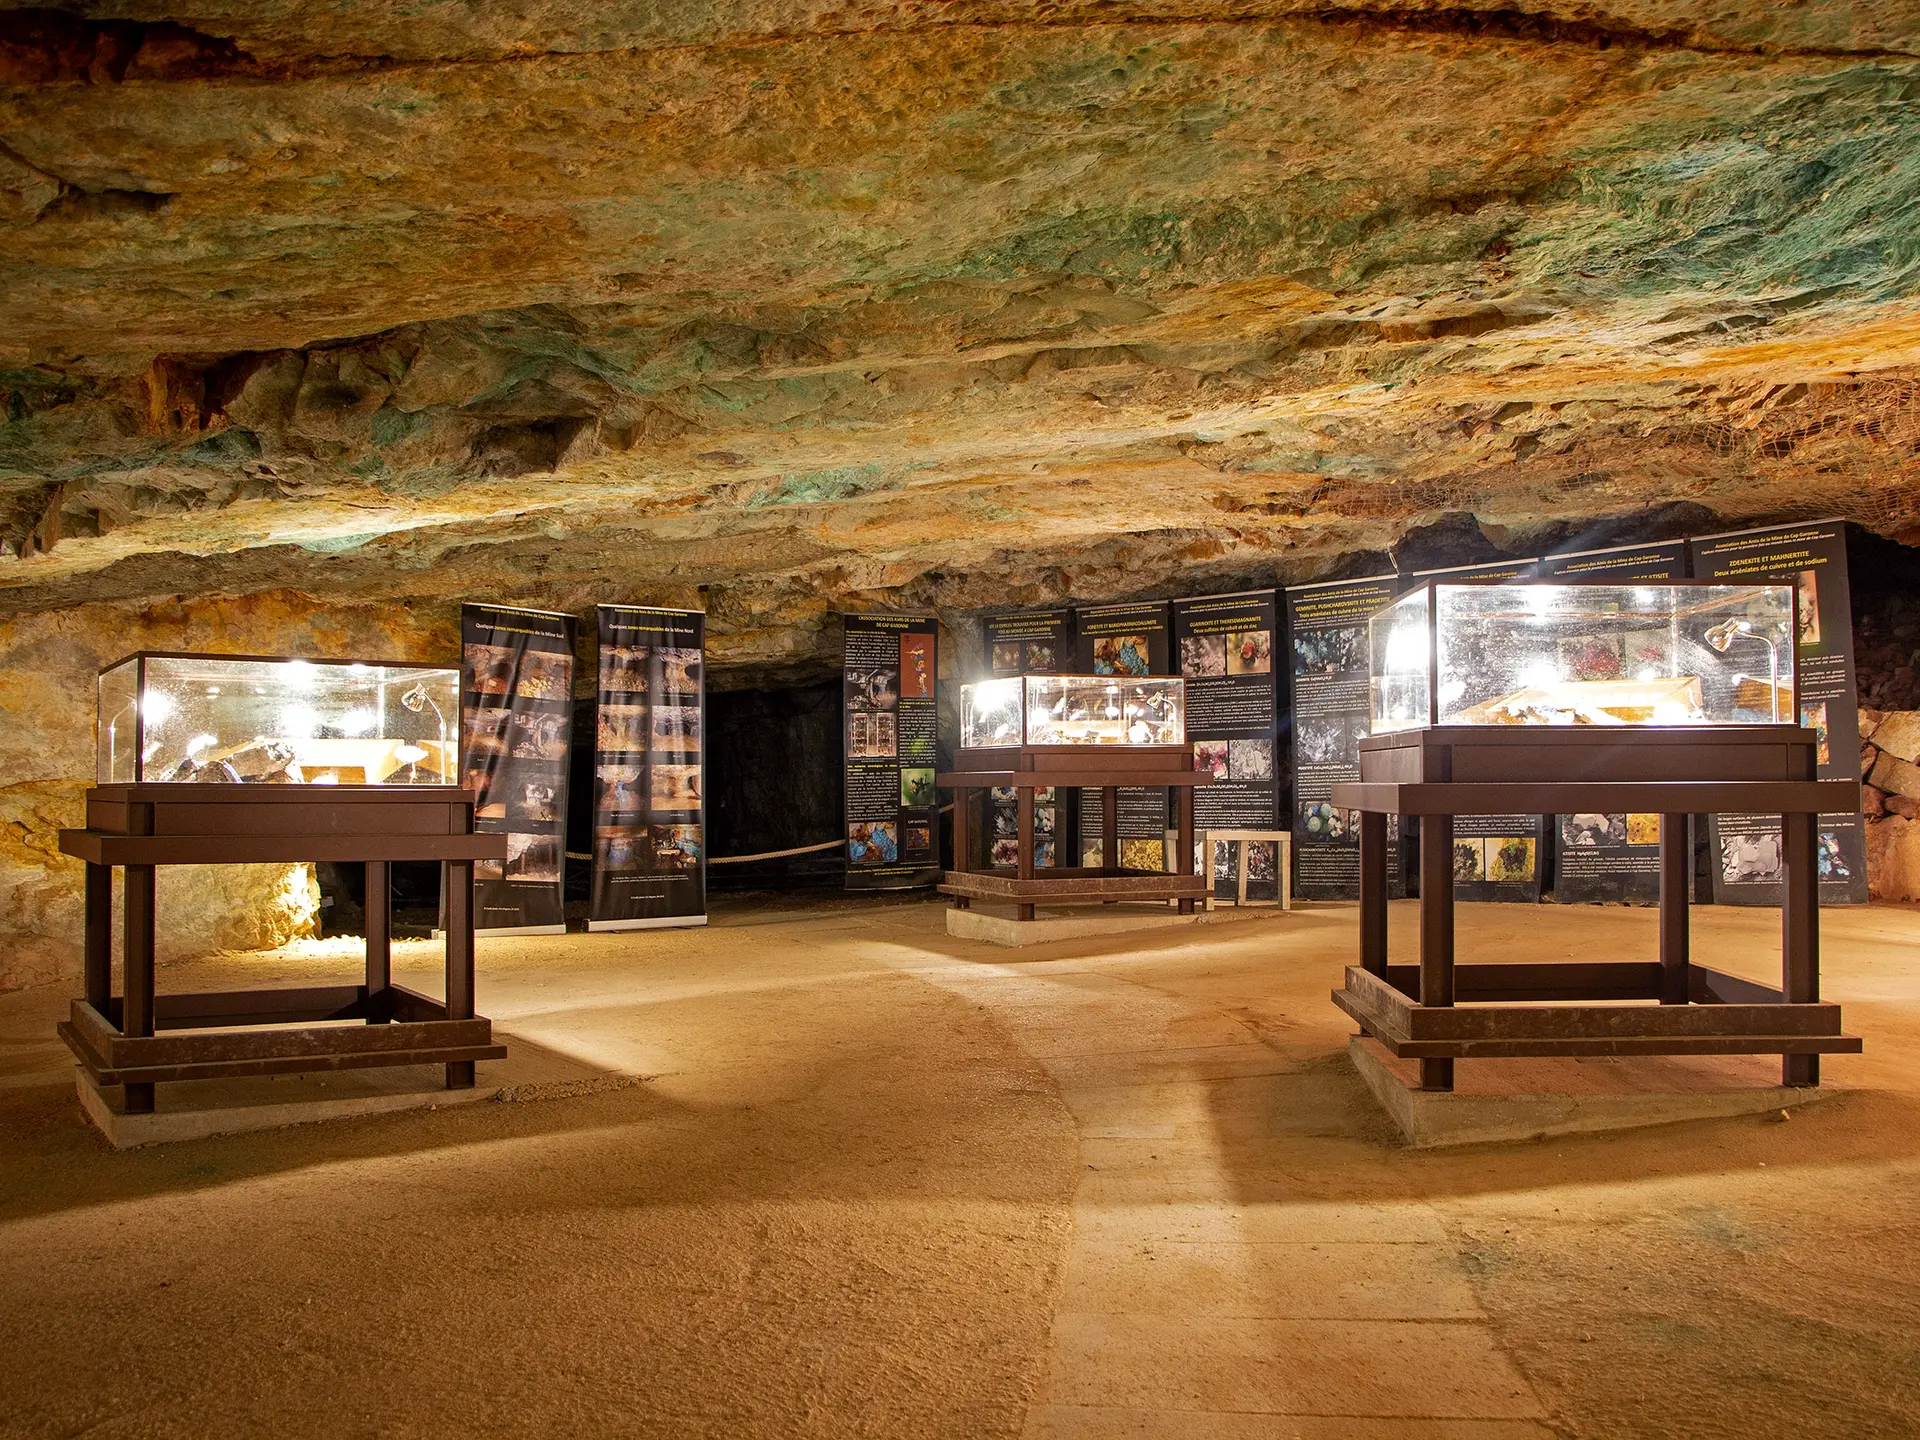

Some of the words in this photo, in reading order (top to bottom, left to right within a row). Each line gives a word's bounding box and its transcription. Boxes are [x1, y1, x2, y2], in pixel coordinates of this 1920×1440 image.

[1715, 540, 1739, 548] Association
[1728, 556, 1760, 566] ZDENEKITE
[1770, 550, 1809, 561] MAHNERTITE
[1730, 565, 1759, 575] arséniates
[1768, 562, 1786, 570] cuivre
[1804, 557, 1827, 565] sodium
